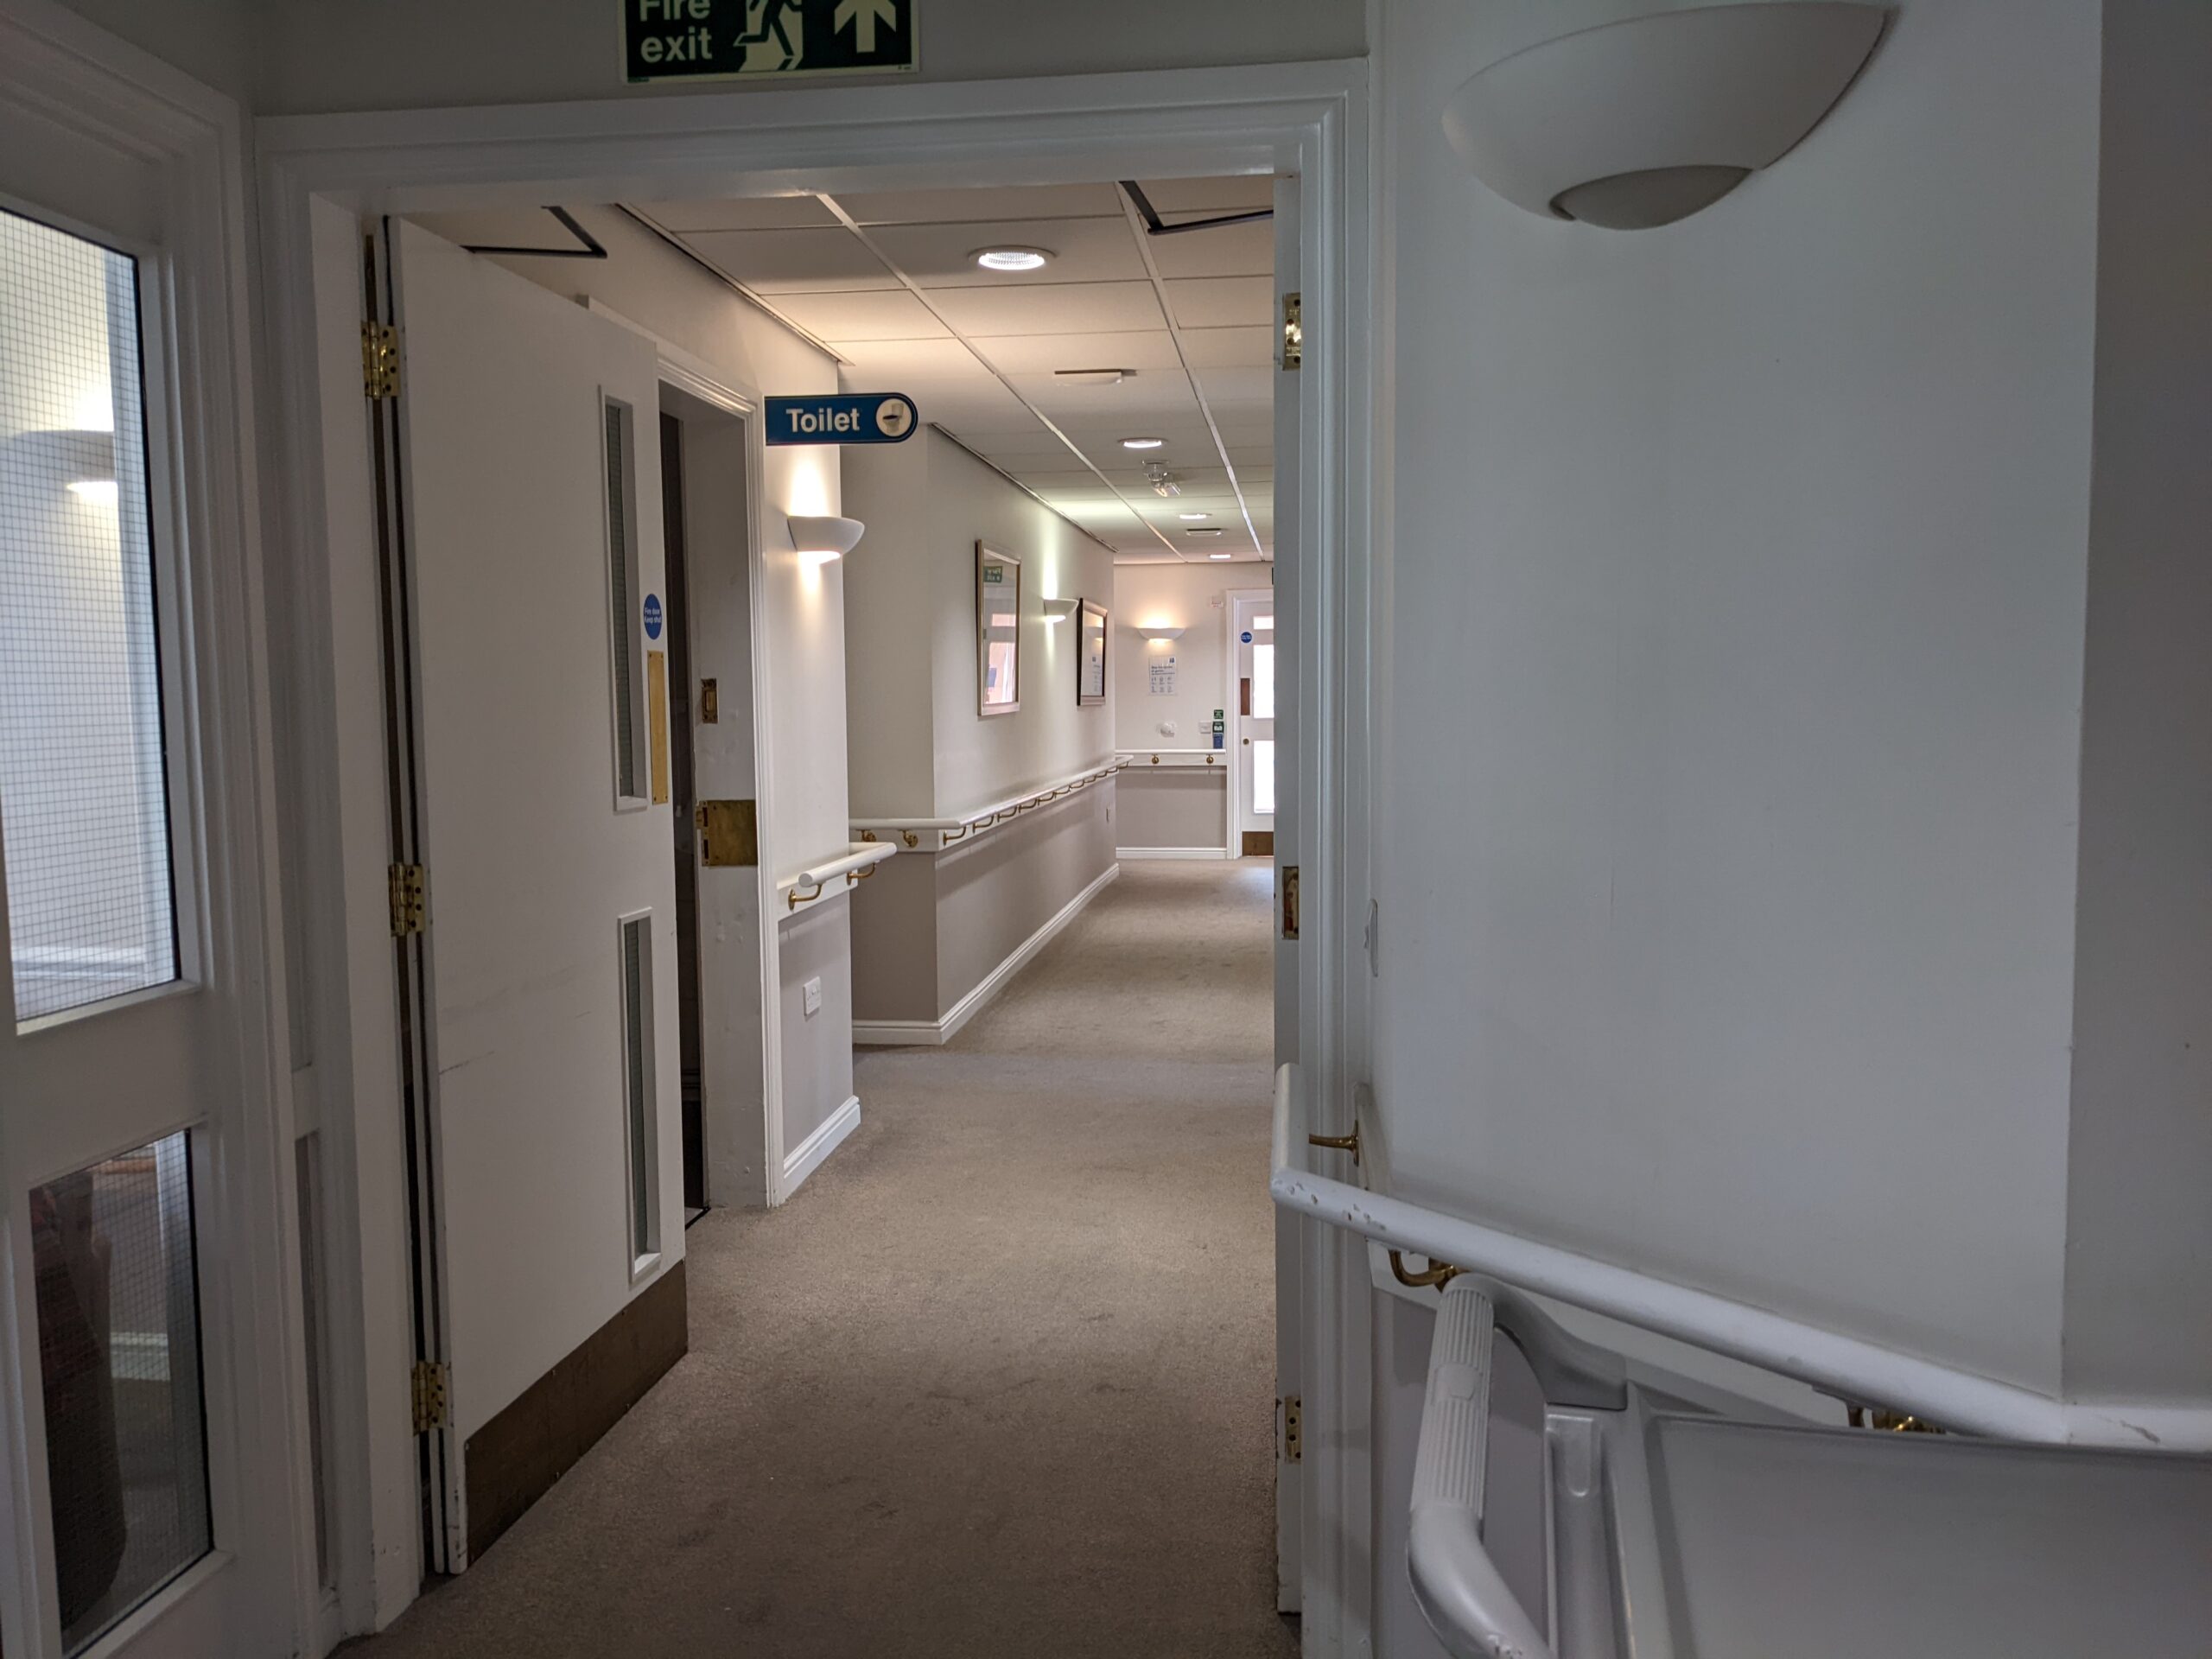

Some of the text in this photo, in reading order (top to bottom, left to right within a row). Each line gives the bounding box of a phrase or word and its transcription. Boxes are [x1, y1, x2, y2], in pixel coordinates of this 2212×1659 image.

[639, 0, 711, 22] Fire
[640, 25, 713, 64] exit
[785, 407, 861, 433] Toilet
